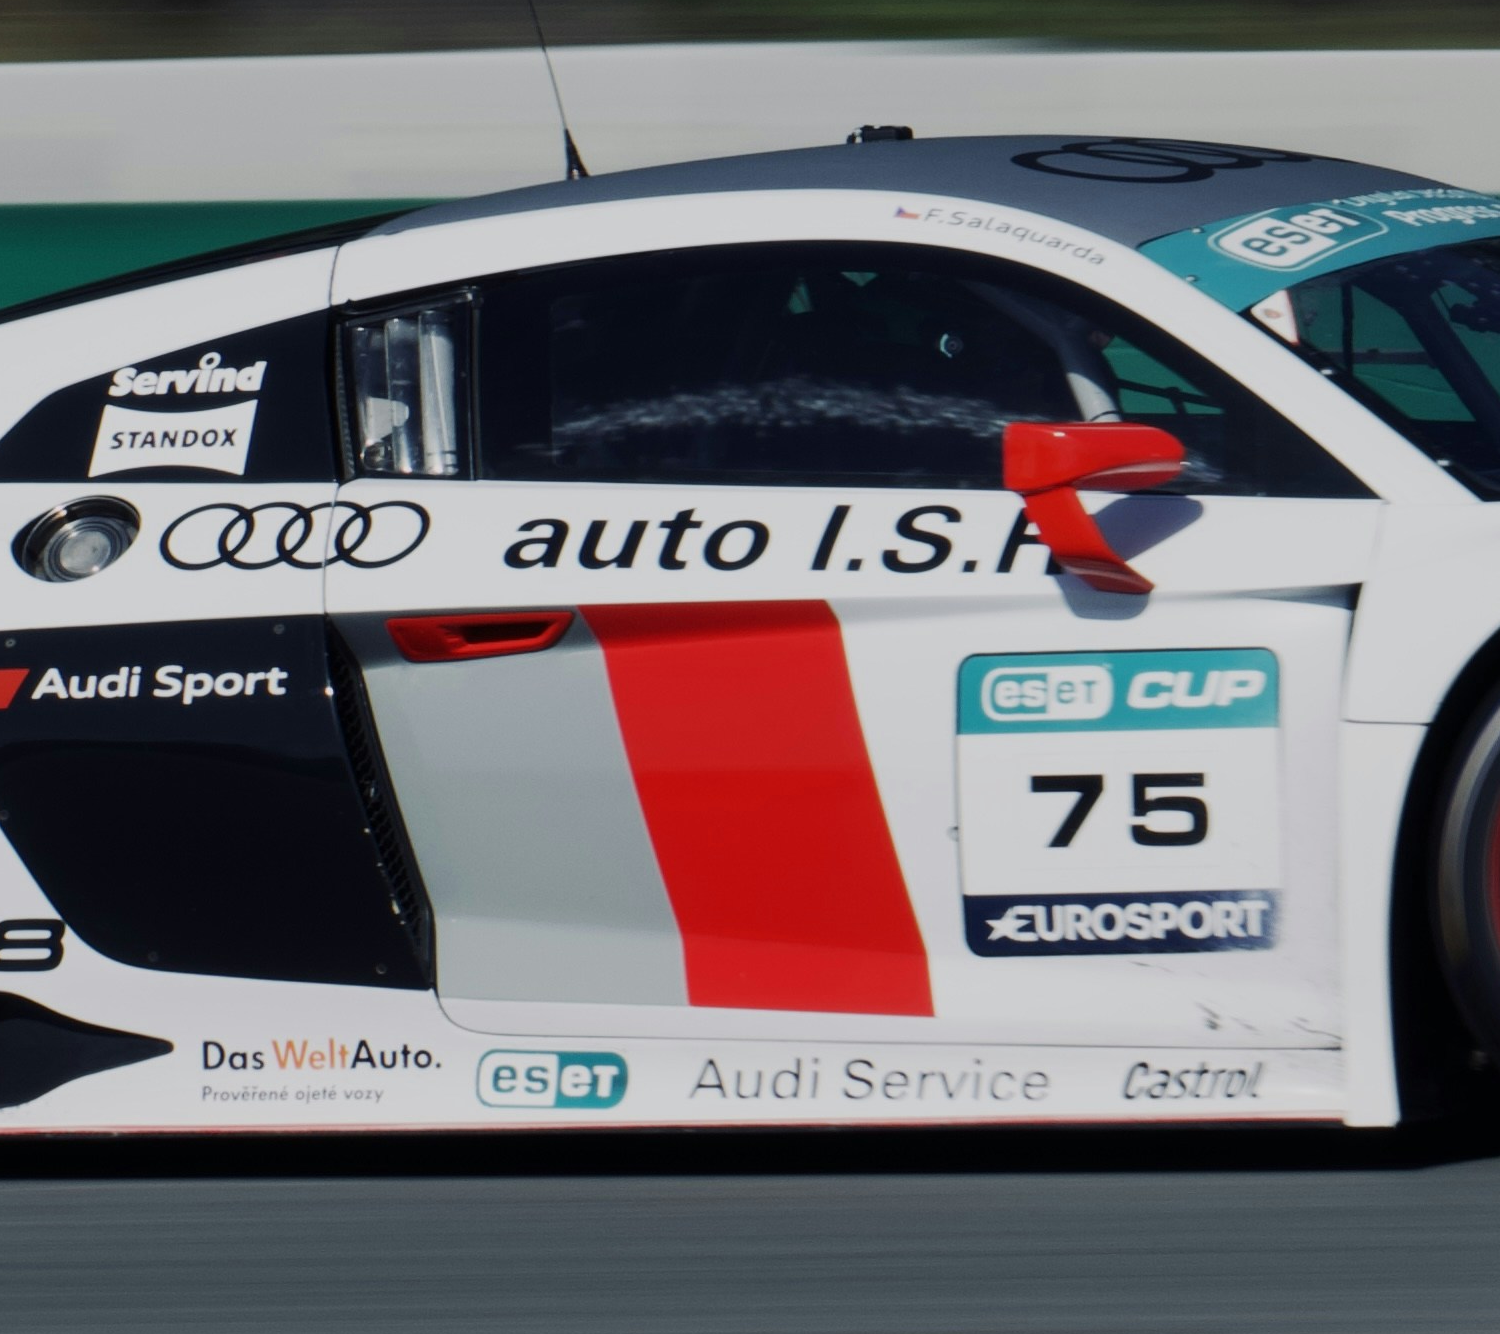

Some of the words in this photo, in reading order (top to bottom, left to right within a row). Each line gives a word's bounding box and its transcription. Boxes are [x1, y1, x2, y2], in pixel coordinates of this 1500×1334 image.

[924, 208, 1106, 265] F.Salaquarda
[108, 351, 267, 397] Servind
[110, 428, 237, 450] STANDOX
[503, 507, 770, 571] auto
[31, 666, 142, 700] Audi
[153, 665, 289, 705] Sport
[1126, 670, 1267, 709] CUP
[1030, 772, 1209, 849] 75
[997, 900, 1269, 943] EUROSPORT
[202, 1041, 264, 1069] Das
[202, 1085, 288, 1102] Prověřené
[344, 1090, 384, 1104] vozy
[689, 1058, 820, 1100] Audi
[843, 1058, 1051, 1101] Service
[1122, 1061, 1264, 1100] Castrol
